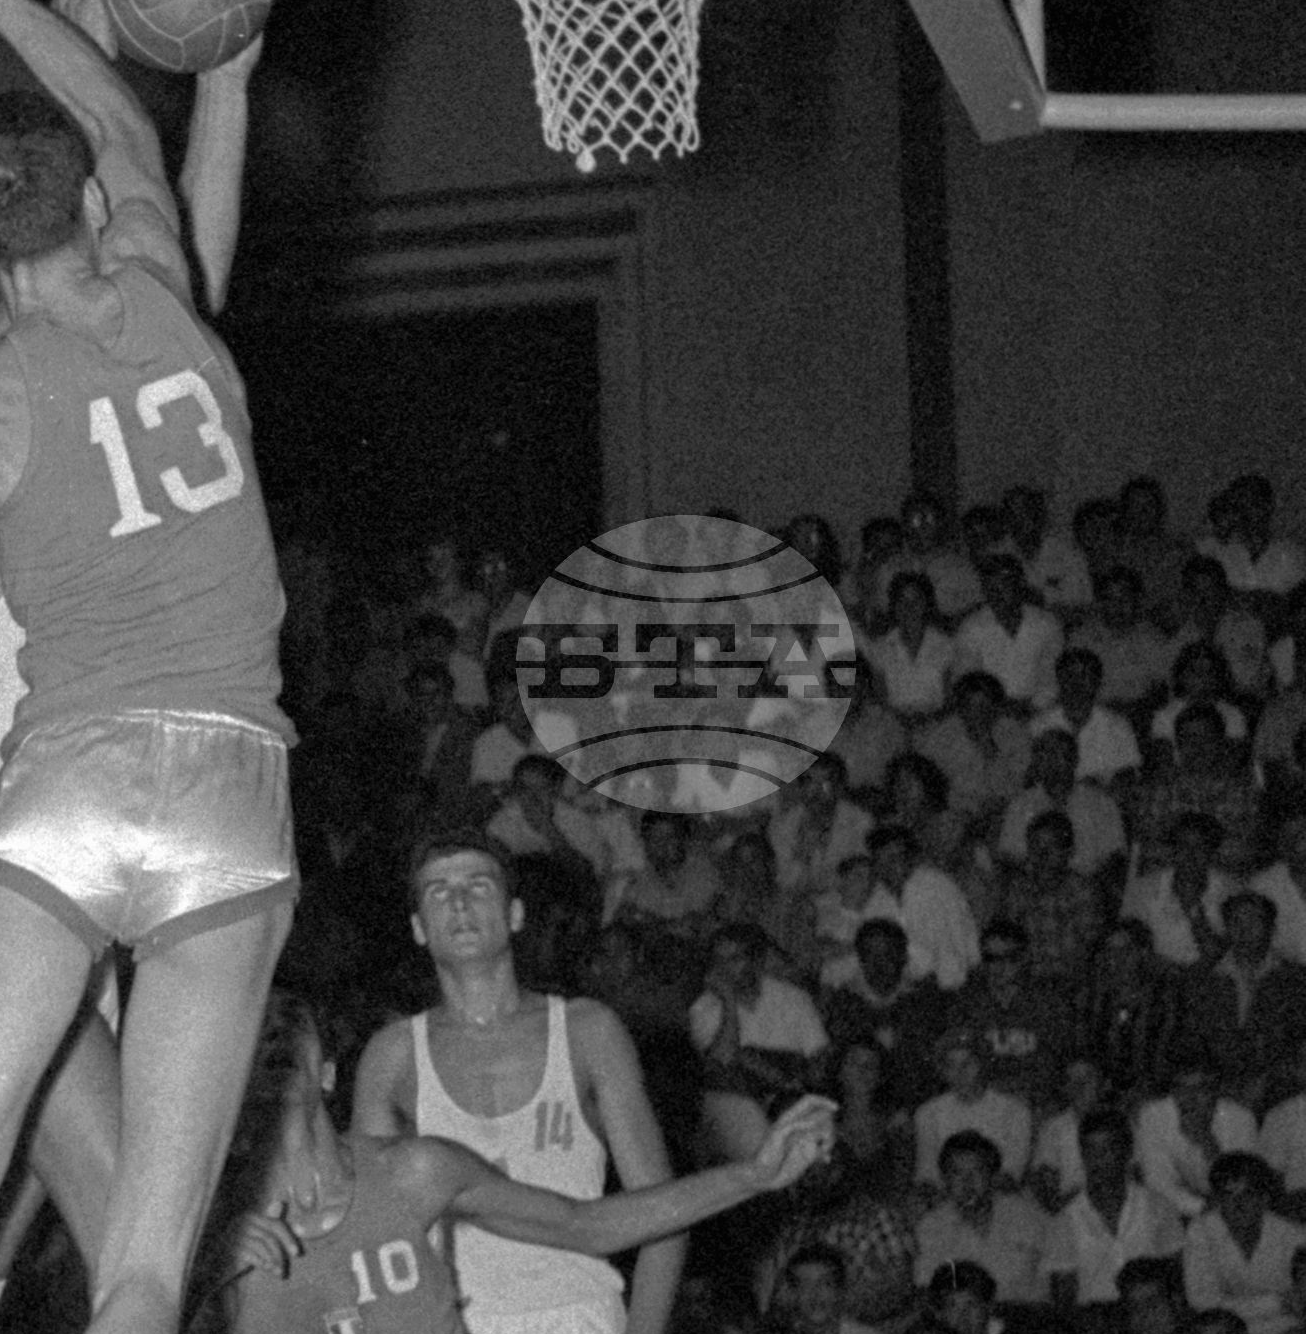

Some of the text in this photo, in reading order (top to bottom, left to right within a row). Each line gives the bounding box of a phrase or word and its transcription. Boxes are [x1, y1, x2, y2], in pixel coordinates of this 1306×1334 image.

[89, 369, 245, 538] 13
[534, 1101, 575, 1153] 14
[351, 1239, 419, 1304] 10
